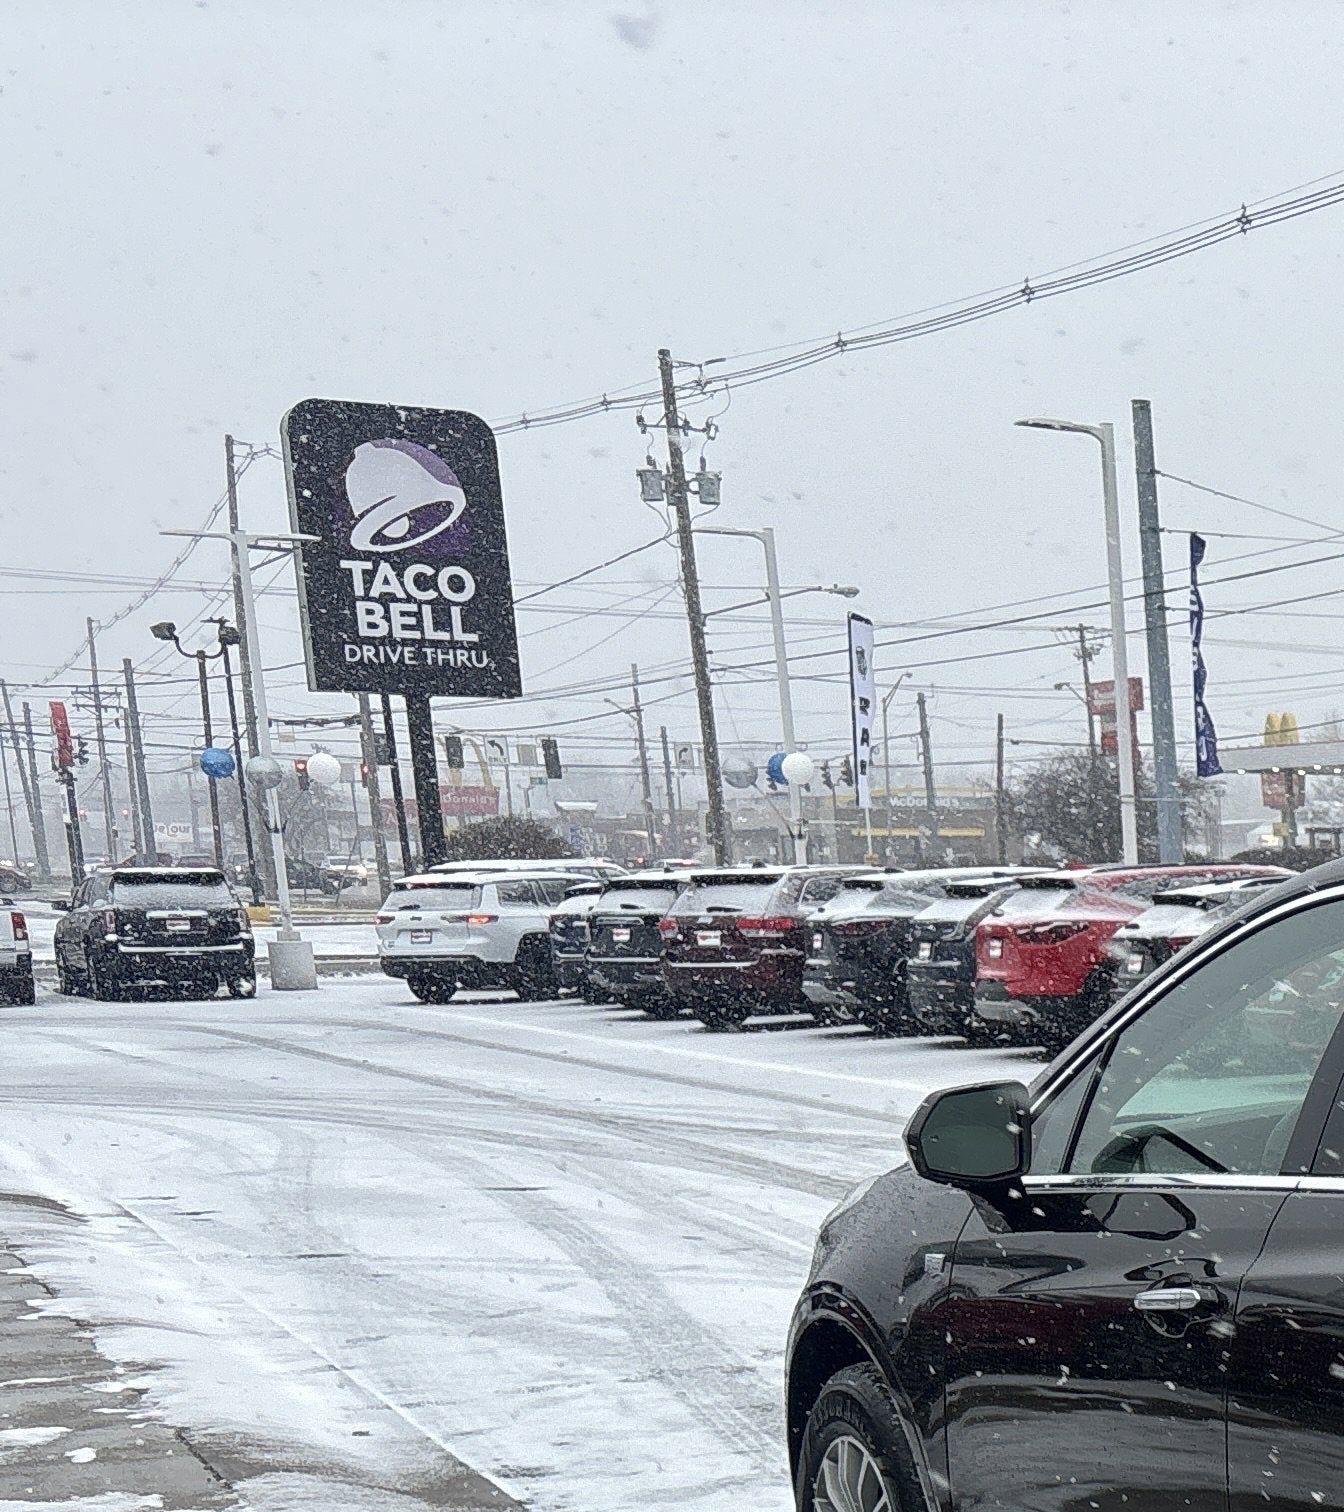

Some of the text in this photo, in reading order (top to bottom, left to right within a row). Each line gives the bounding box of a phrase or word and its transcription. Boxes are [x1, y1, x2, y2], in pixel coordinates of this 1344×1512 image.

[339, 559, 476, 602] TACO
[355, 600, 480, 642] BELL
[344, 644, 489, 669] DRIVE THRU
